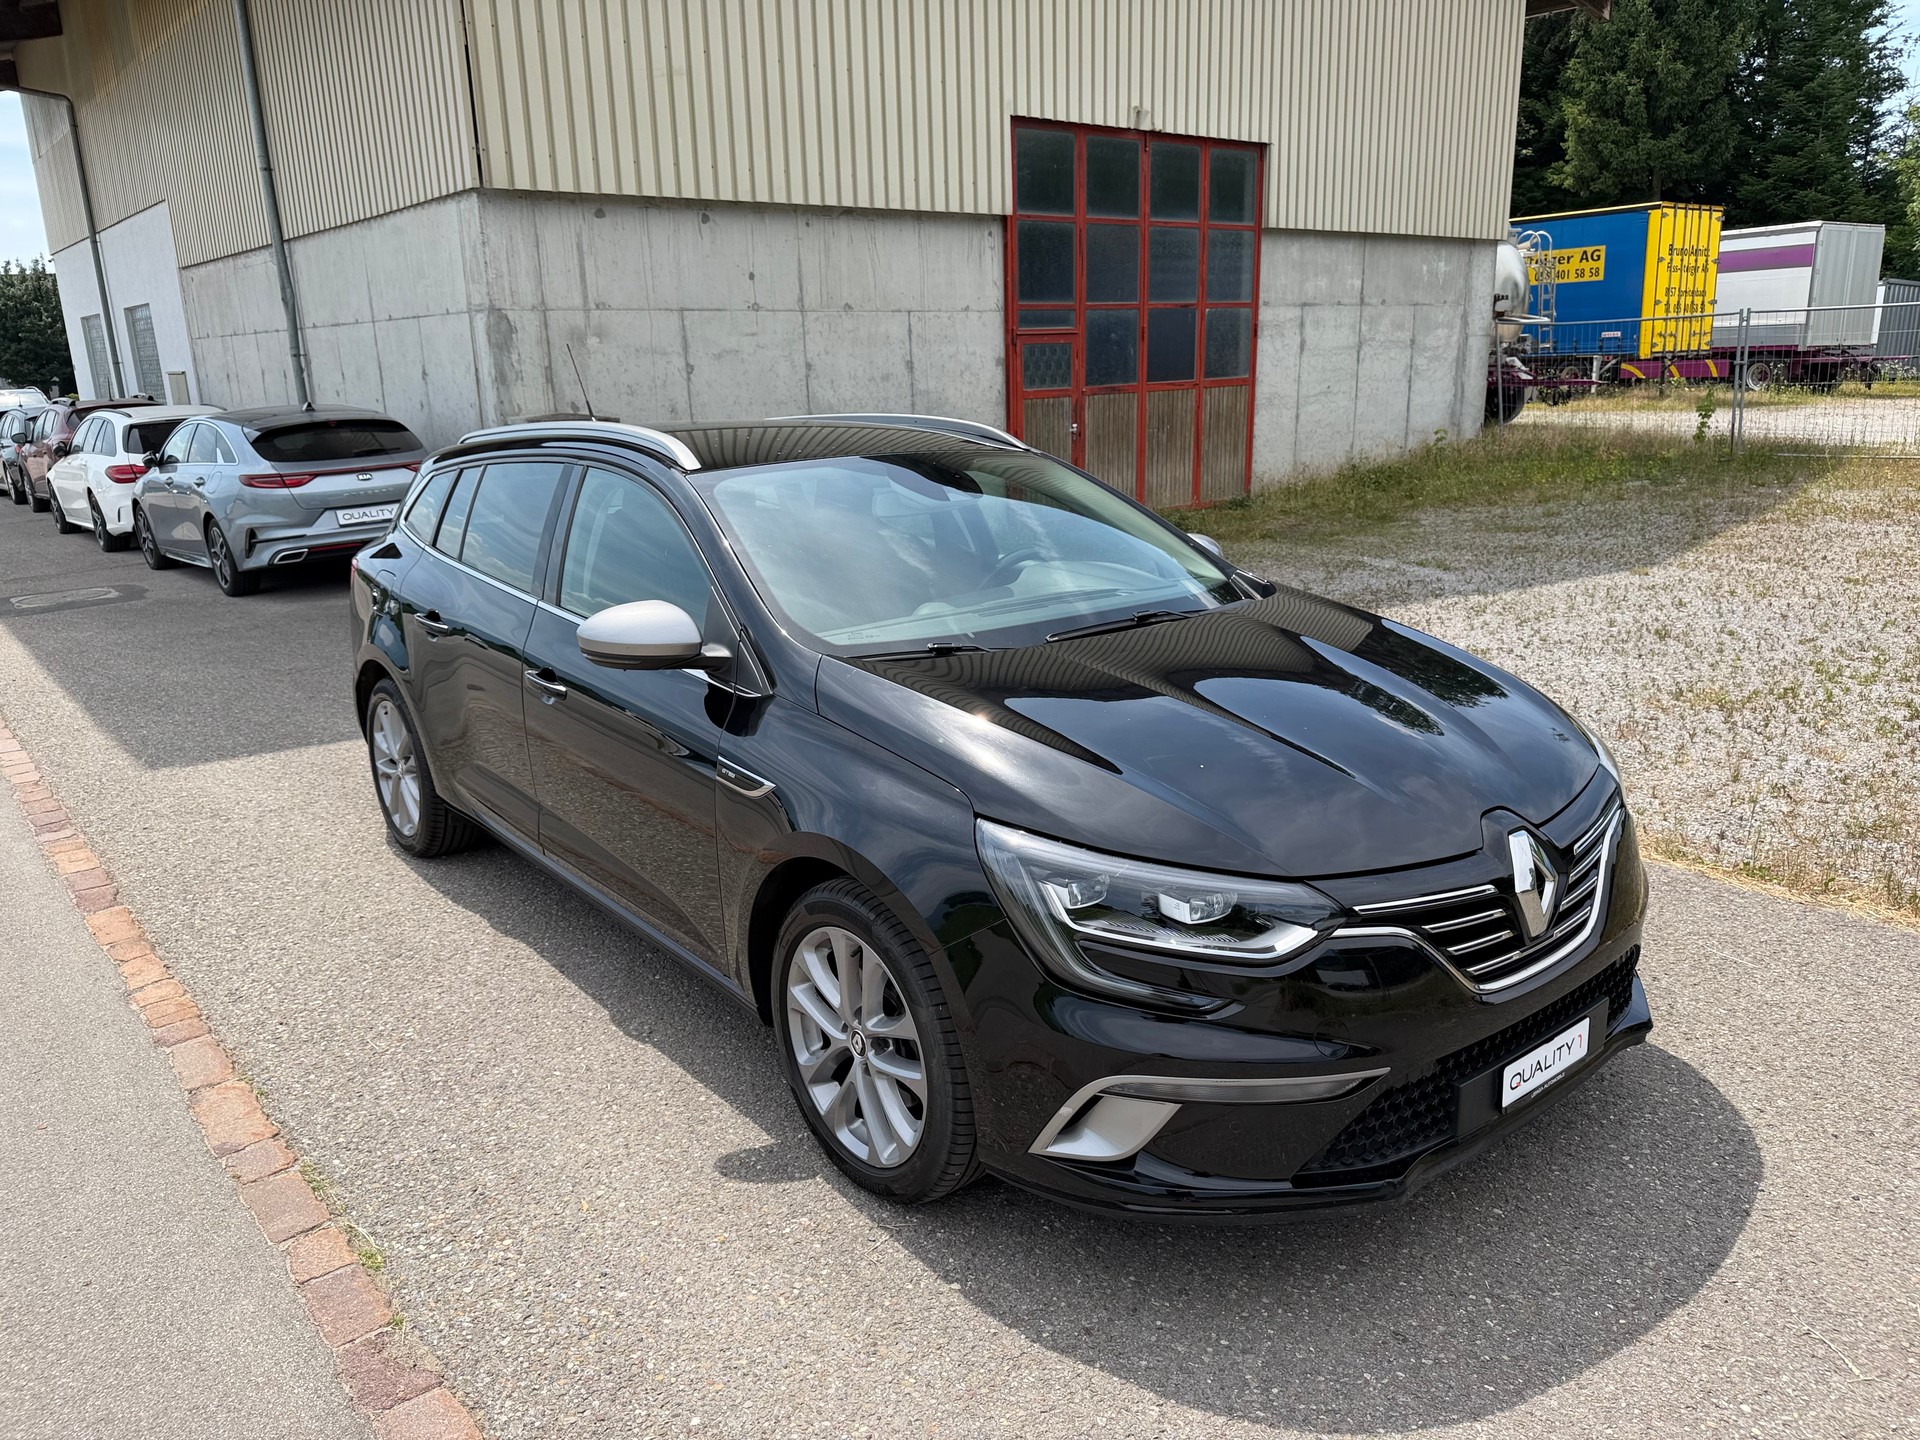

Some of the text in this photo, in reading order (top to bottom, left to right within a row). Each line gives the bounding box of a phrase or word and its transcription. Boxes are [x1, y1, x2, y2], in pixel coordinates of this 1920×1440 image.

[1579, 249, 1602, 264] AG
[1574, 268, 1586, 279] 58
[1588, 266, 1601, 278] 58
[342, 508, 395, 521] QUALITY
[1509, 1033, 1583, 1091] QUALITY 1
